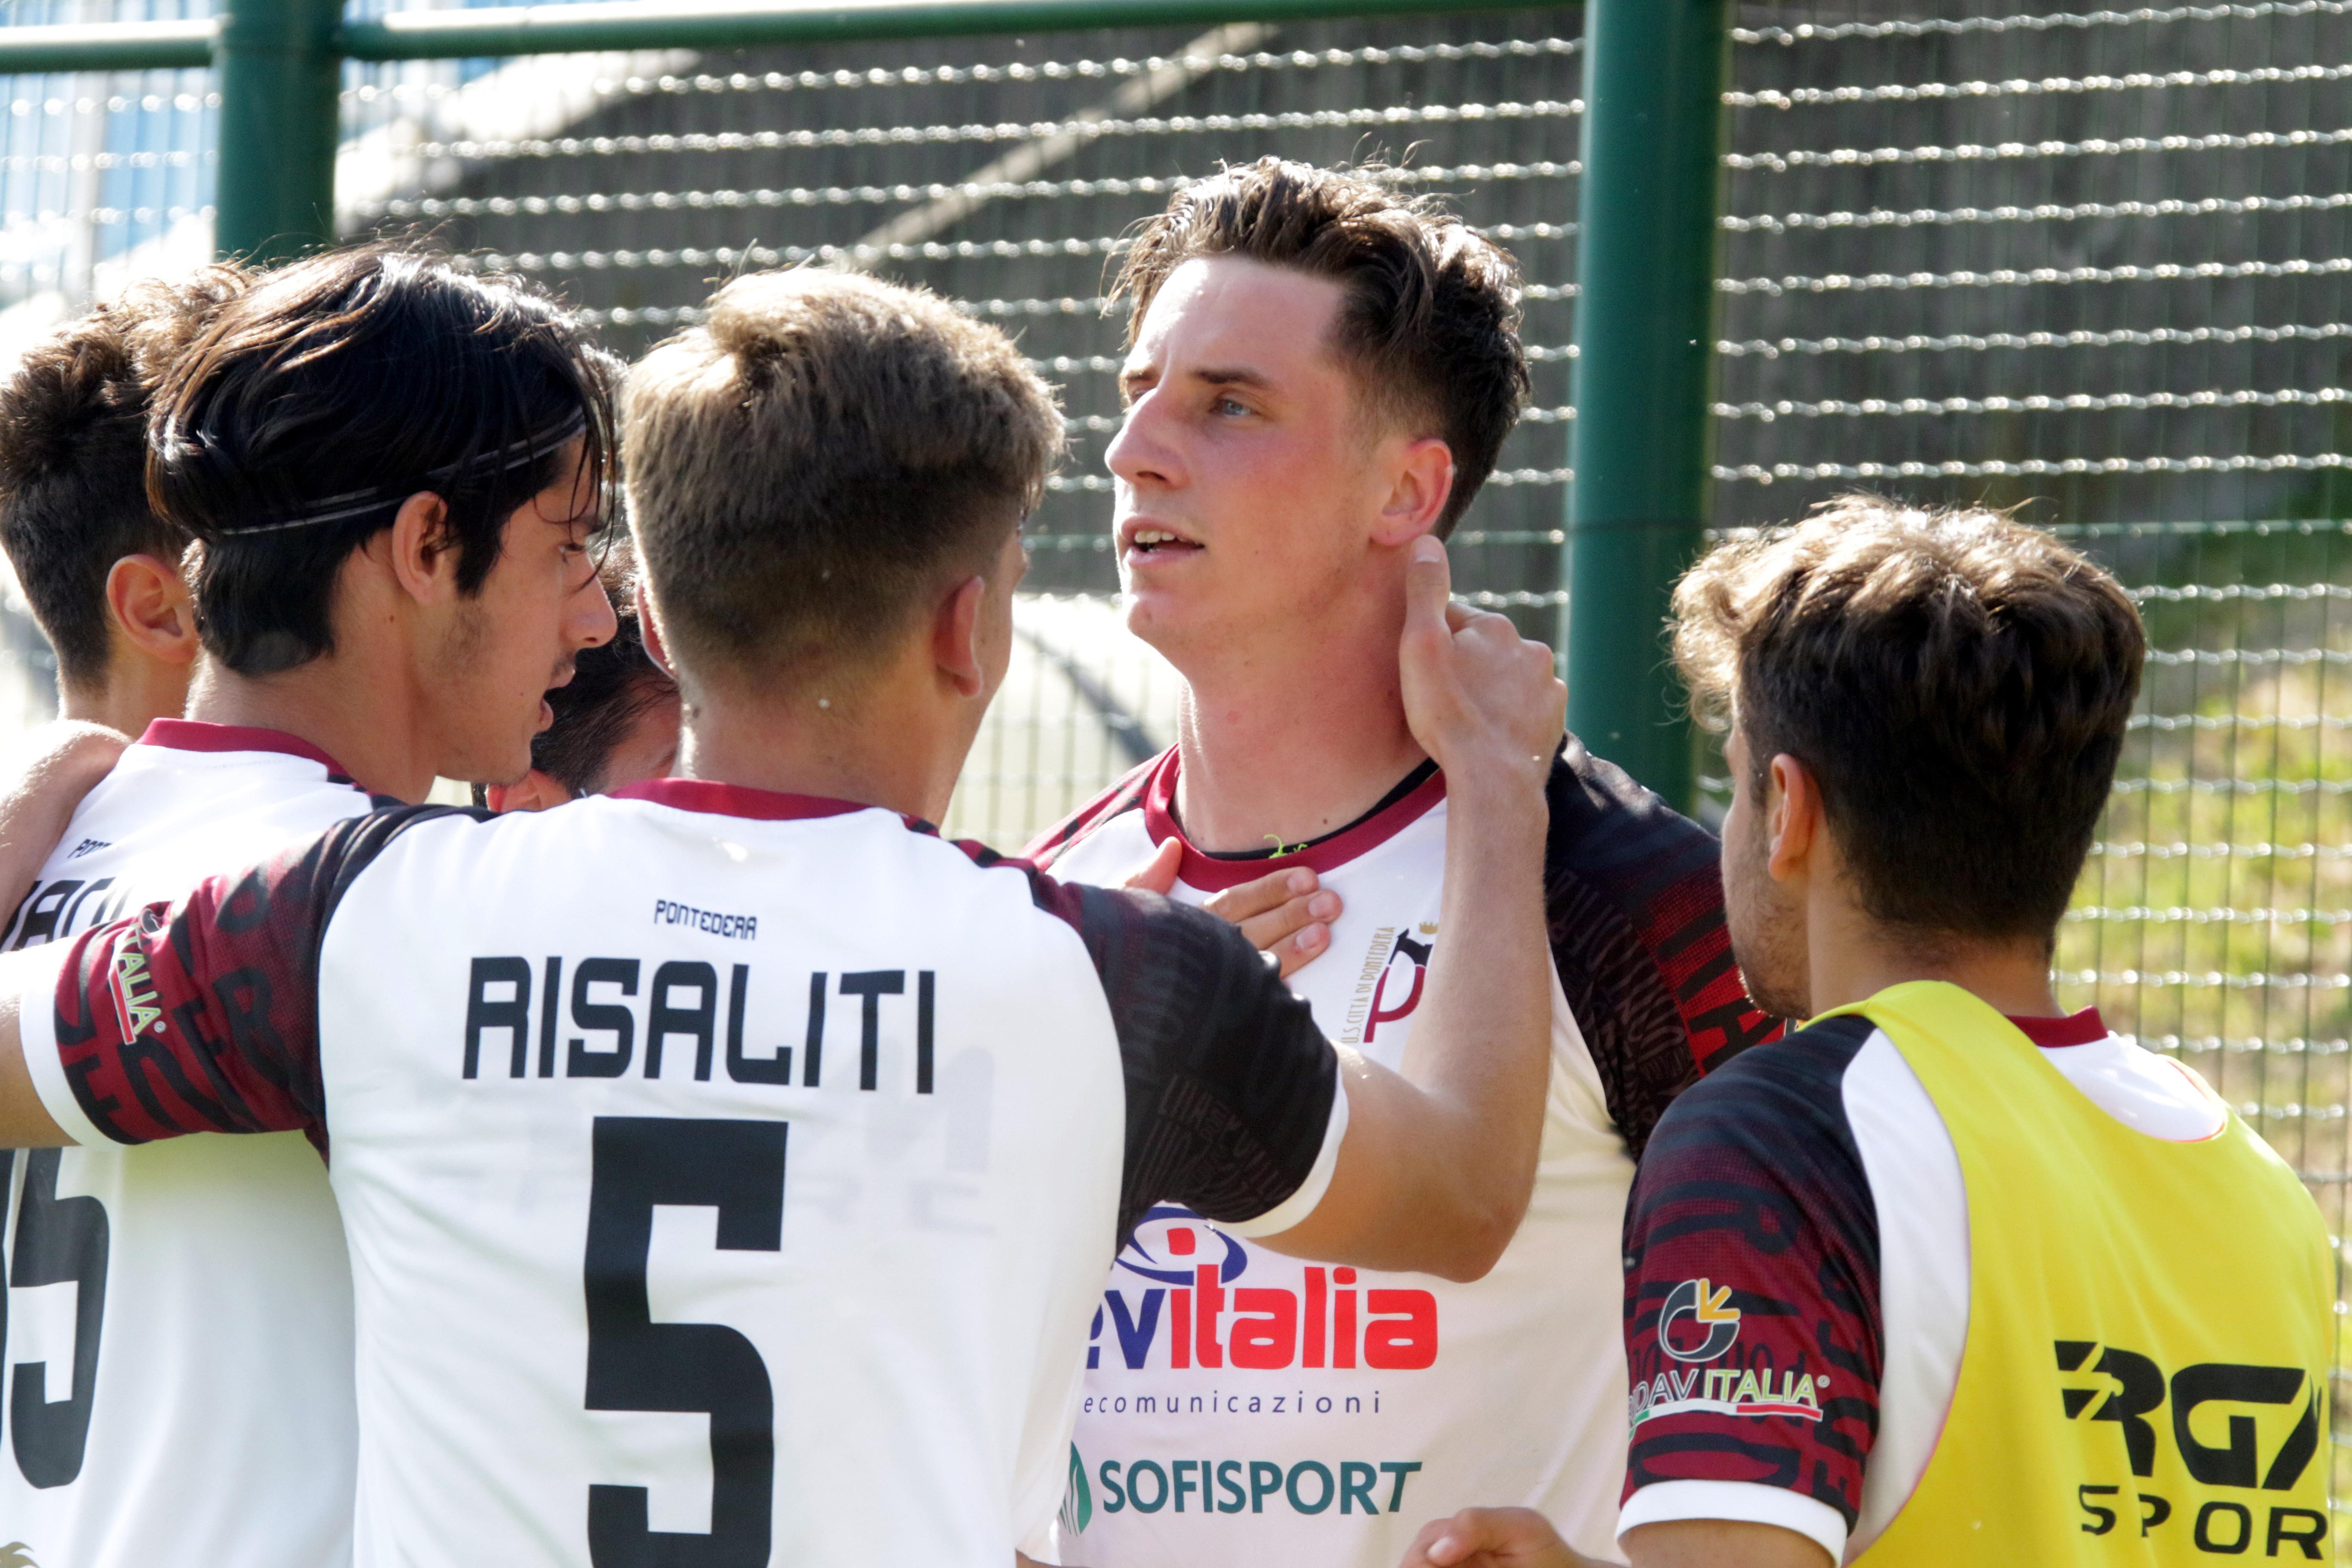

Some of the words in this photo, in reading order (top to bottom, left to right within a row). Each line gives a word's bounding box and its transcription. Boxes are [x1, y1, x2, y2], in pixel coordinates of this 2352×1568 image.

[654, 899, 757, 940] PONTEDERA
[1360, 926, 1396, 981] PONTEDERA
[118, 922, 162, 1035] TALIA
[462, 956, 935, 1094] RISALITI
[584, 1116, 789, 1568] 5
[1099, 1460, 1423, 1515] SOFISPORT
